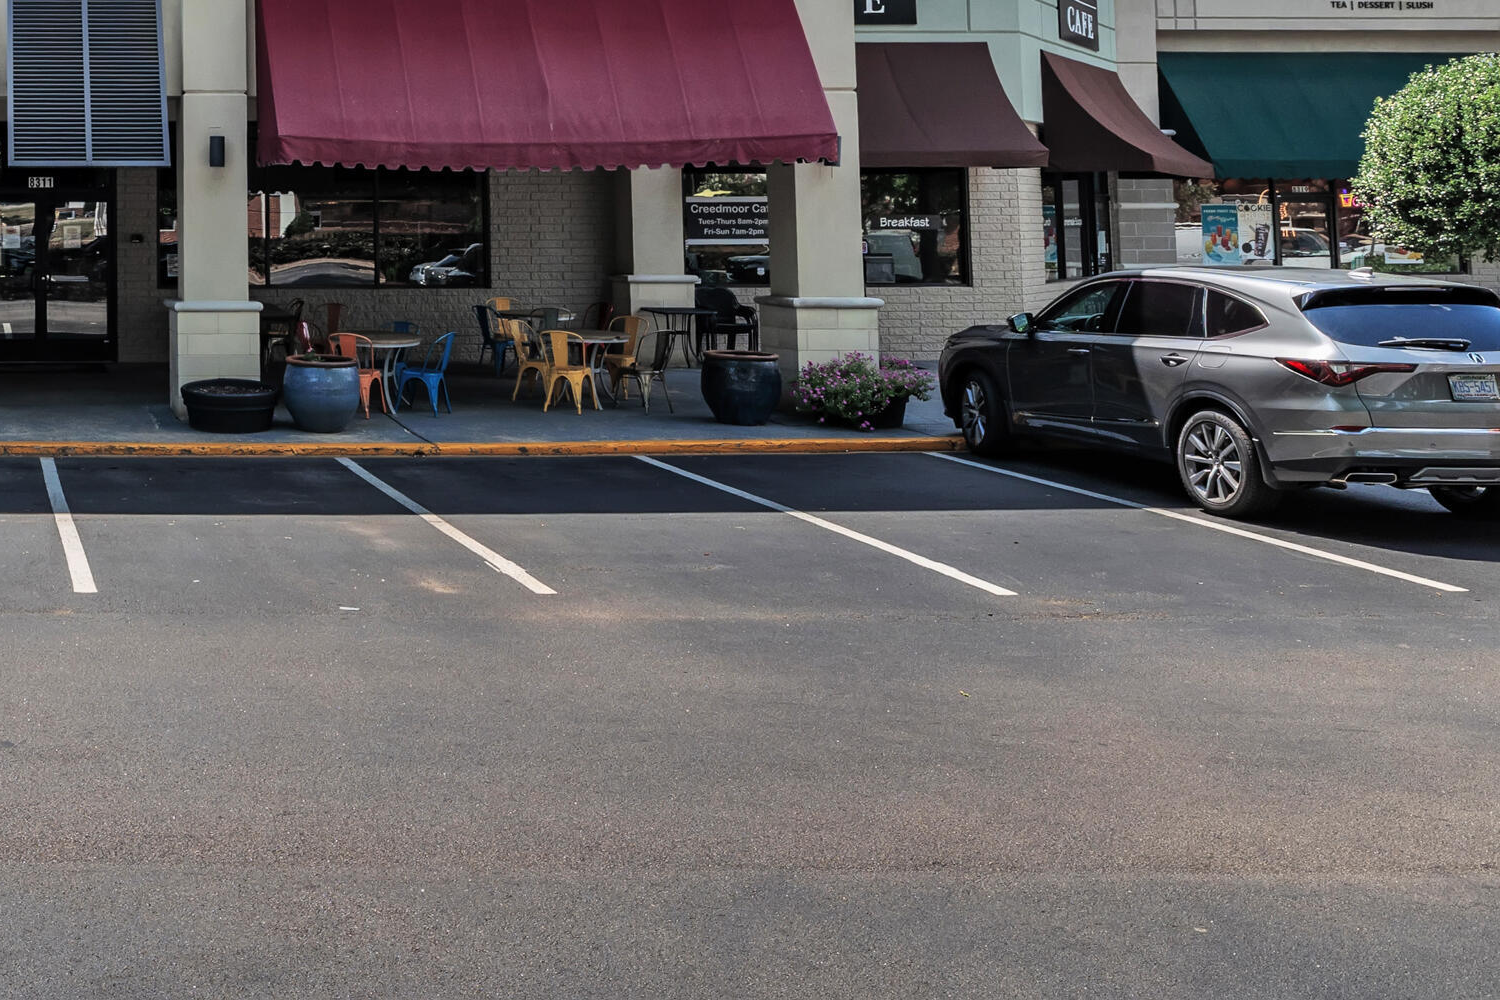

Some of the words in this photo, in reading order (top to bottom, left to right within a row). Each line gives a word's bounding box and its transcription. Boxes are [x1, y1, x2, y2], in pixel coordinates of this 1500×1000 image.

[1330, 1, 1347, 9] TEA
[1358, 1, 1395, 9] DESSERT
[1067, 6, 1094, 39] CAFE
[29, 177, 52, 188] 8311
[690, 204, 749, 214] Creedmoor
[879, 217, 930, 227] Breakfast
[731, 228, 765, 236] 7am-2pm
